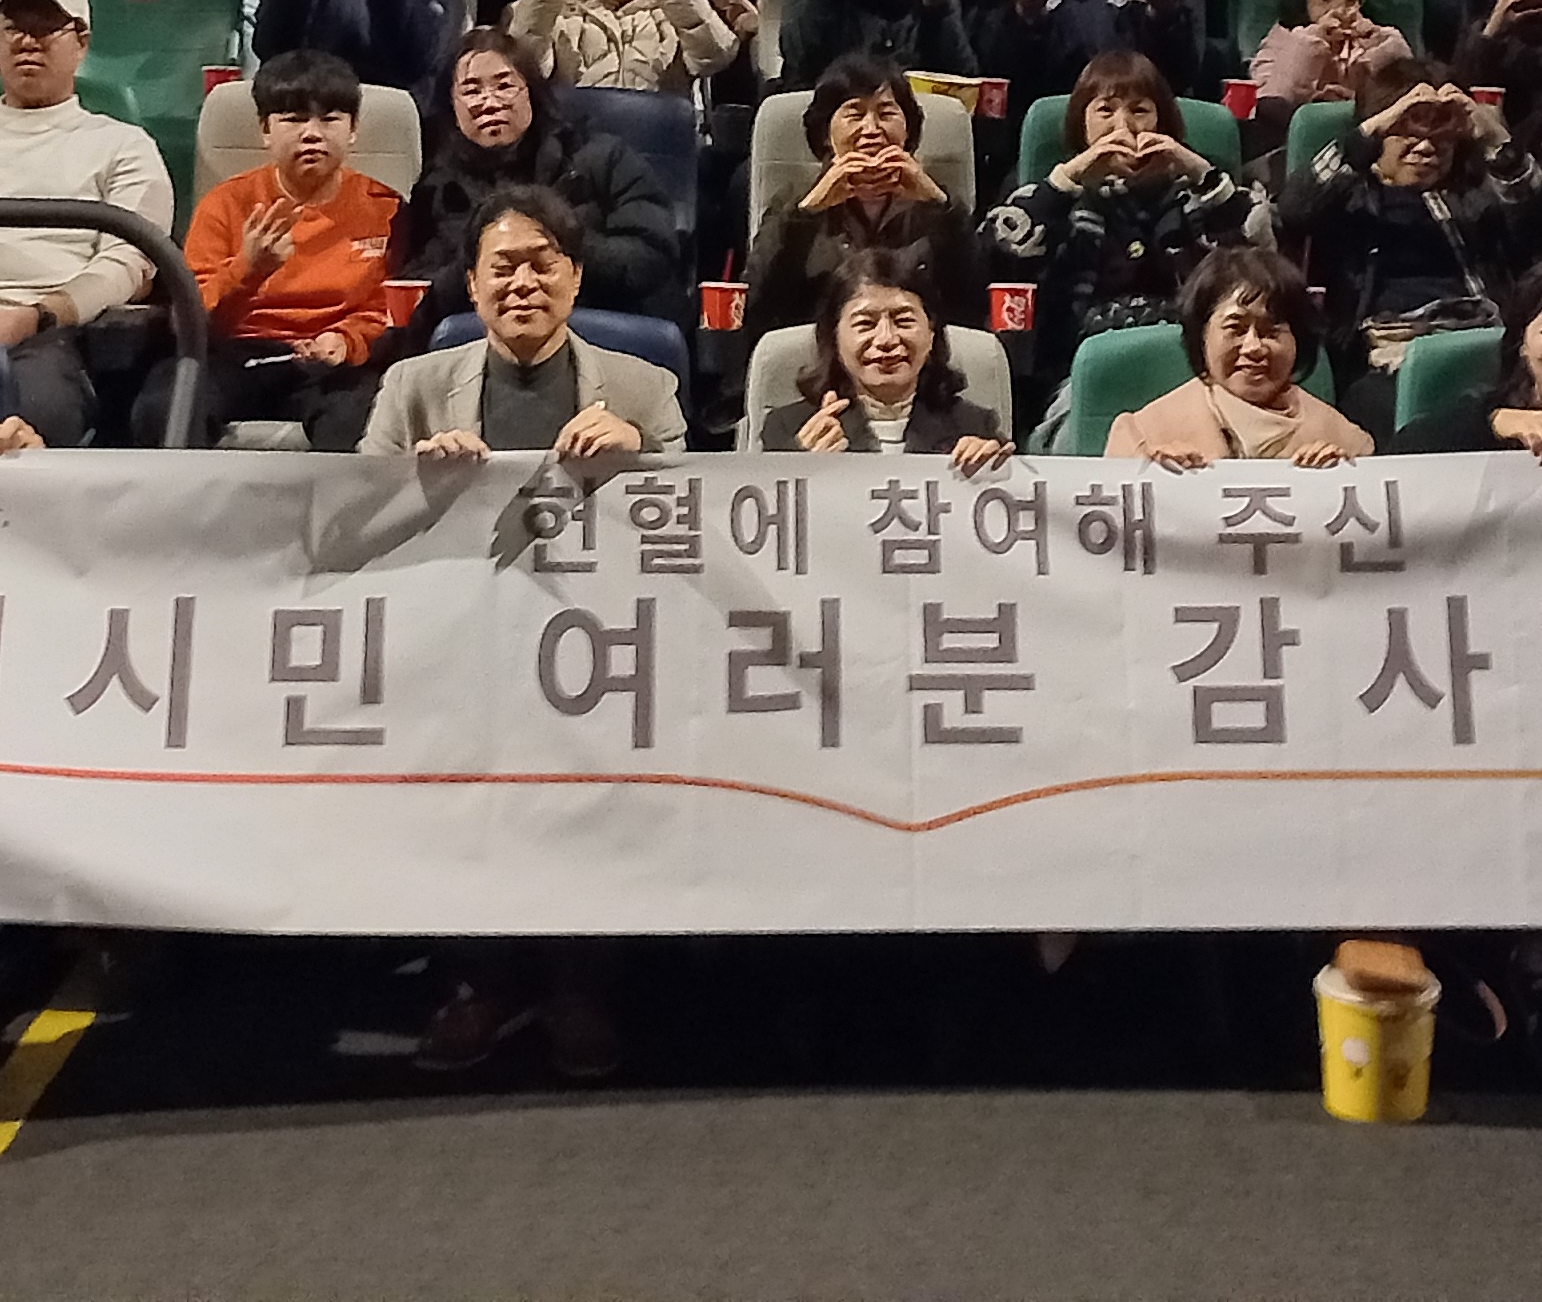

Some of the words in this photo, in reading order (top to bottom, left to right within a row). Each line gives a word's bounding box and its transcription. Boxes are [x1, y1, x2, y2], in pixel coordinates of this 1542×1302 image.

[521, 473, 809, 575] 헌혈에
[869, 477, 1156, 577] 참여해
[1216, 479, 1407, 576] 주신
[537, 596, 1036, 749] 여러분
